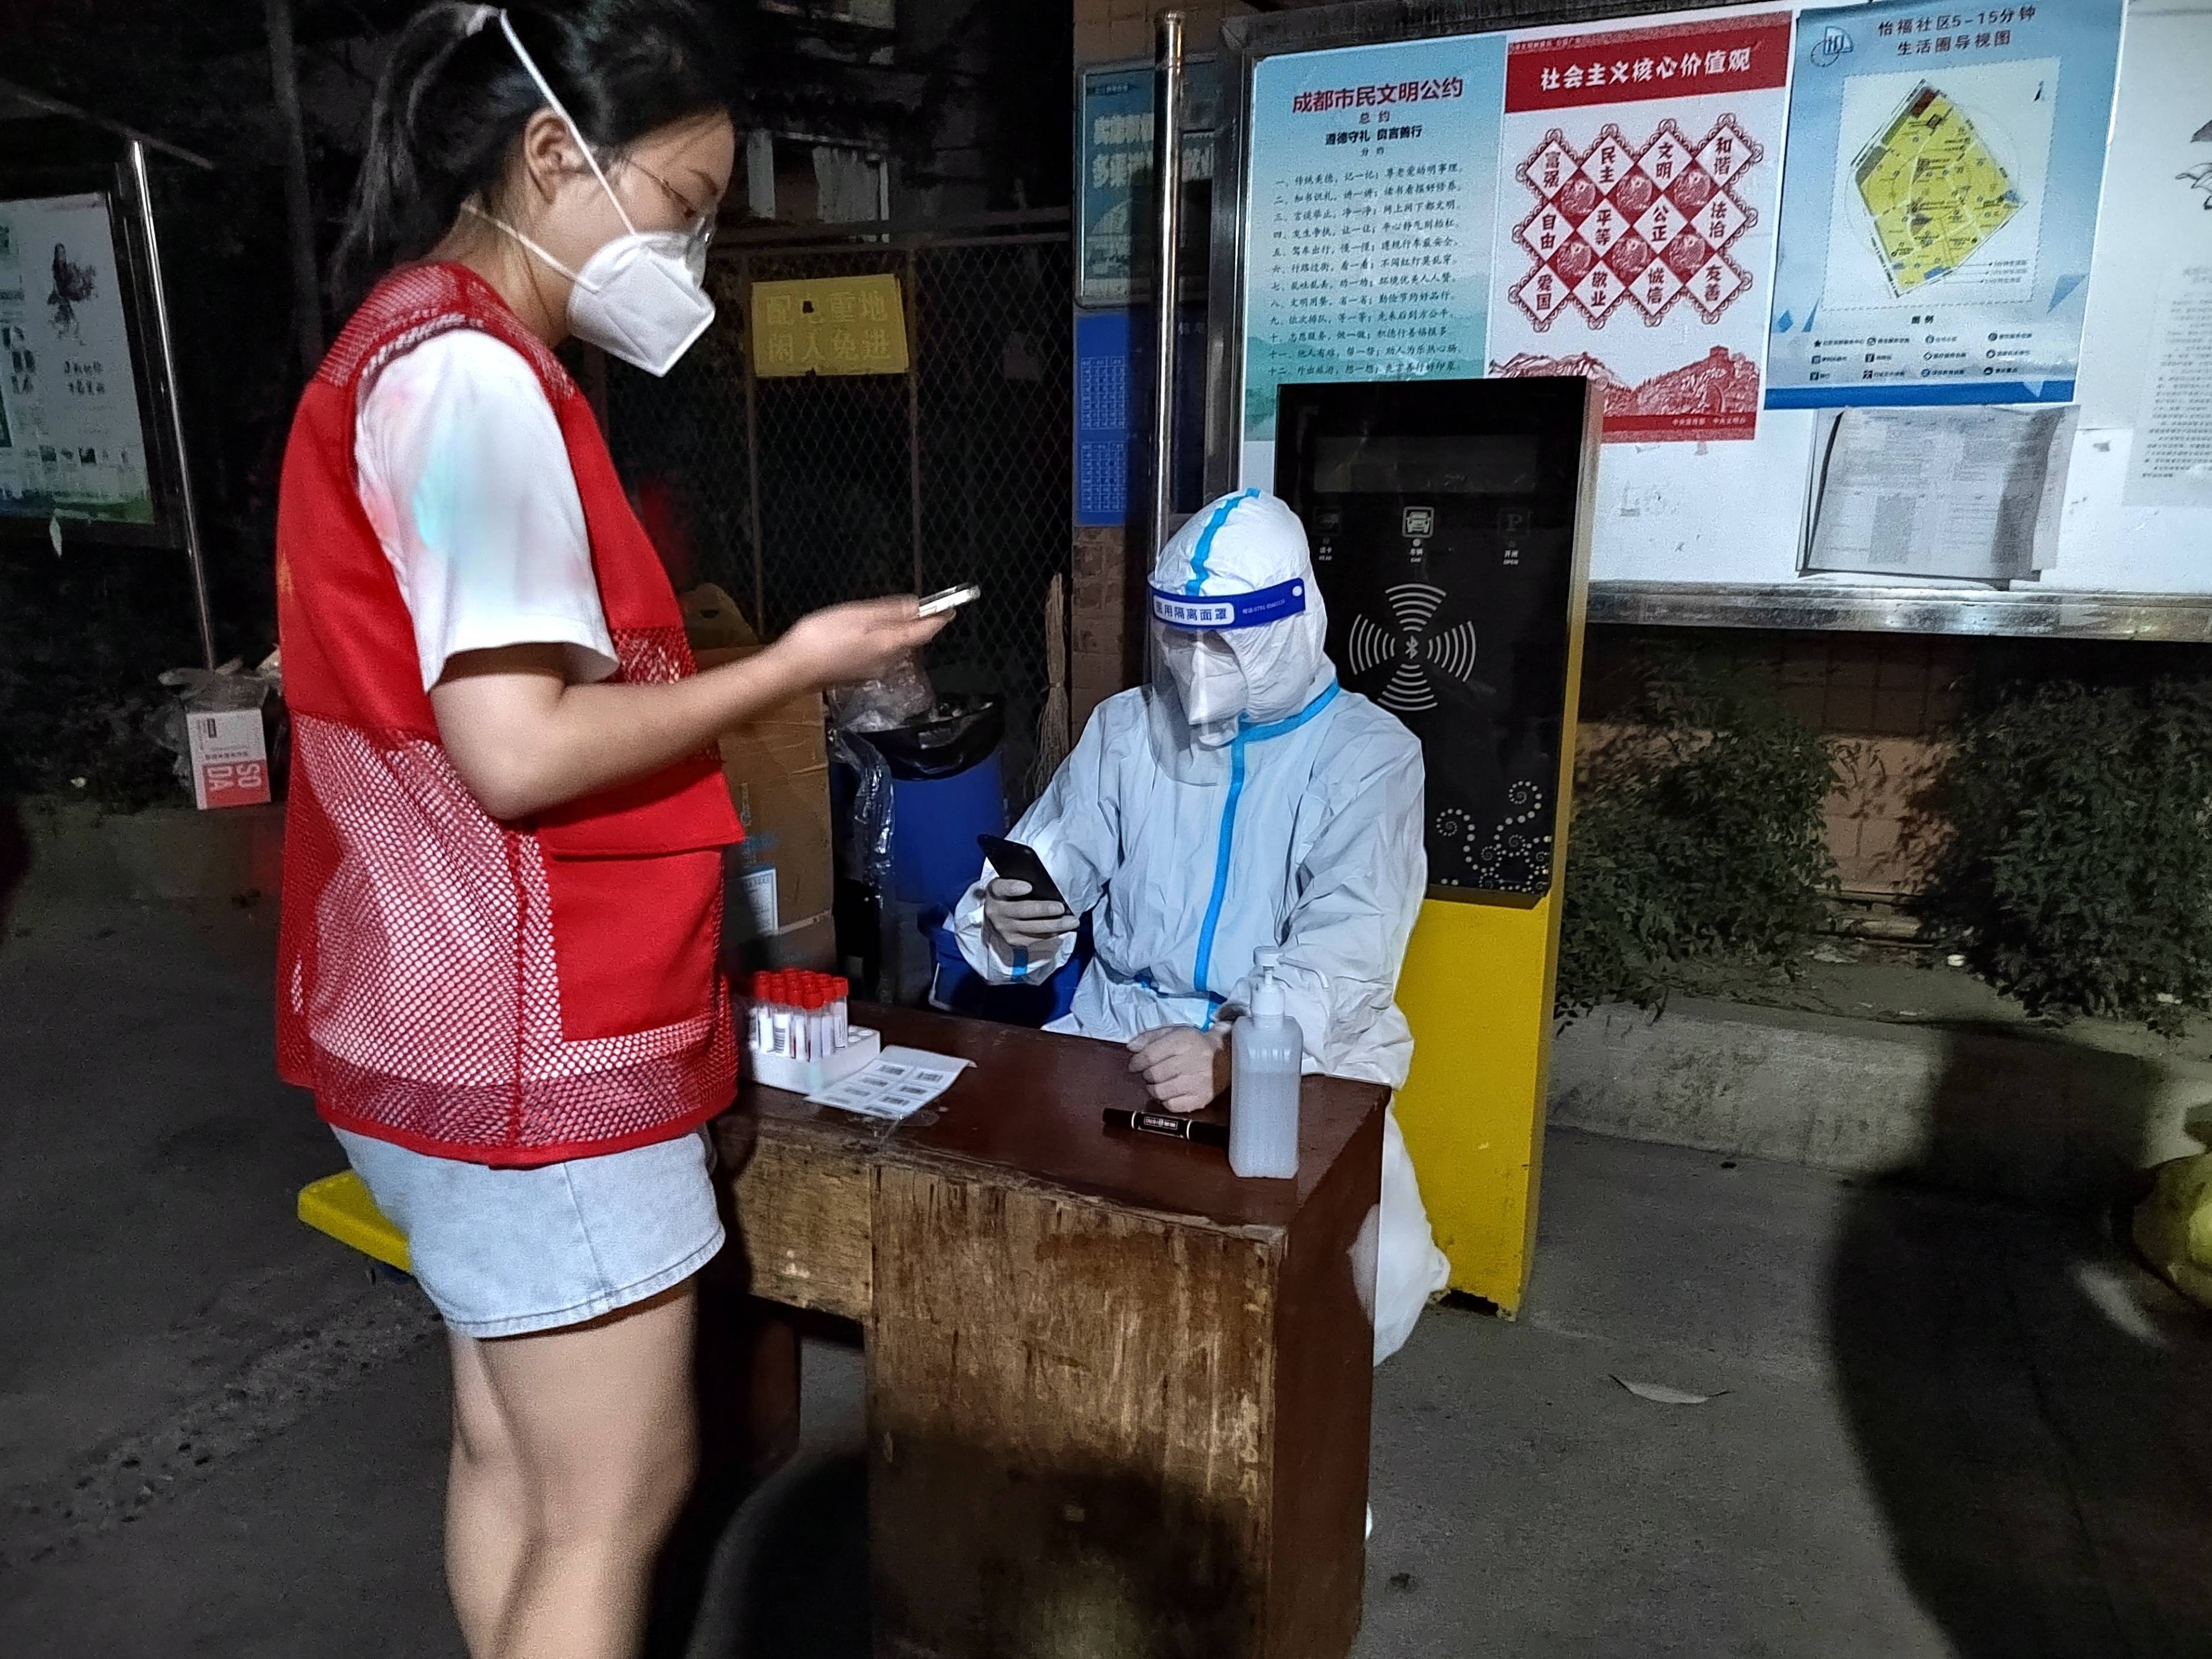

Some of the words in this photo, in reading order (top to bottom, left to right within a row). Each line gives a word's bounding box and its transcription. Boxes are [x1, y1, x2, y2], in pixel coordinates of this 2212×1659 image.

[1878, 6, 2036, 37] 怡福社区5-15分钟
[1897, 30, 2011, 56] 生活圈导视图
[1540, 47, 1751, 91] 社会主义核心价值观
[1293, 77, 1463, 113] 成都市民文明公约
[1325, 130, 1370, 146] 遵德守礼
[1714, 136, 1732, 175] 和谐
[1543, 151, 1561, 188] 富强
[1600, 146, 1614, 183] 民主
[1657, 143, 1674, 179] 文明
[1541, 213, 1557, 250] 自由
[1595, 209, 1612, 246] 平等
[1652, 205, 1669, 242] 公正
[1709, 202, 1726, 238] 法治
[1536, 275, 1552, 311] 爱国
[1591, 272, 1607, 306] 敬业
[1646, 268, 1664, 305] 诚信
[1704, 264, 1722, 302] 友善
[1155, 601, 1227, 621] 医用隔离面罩
